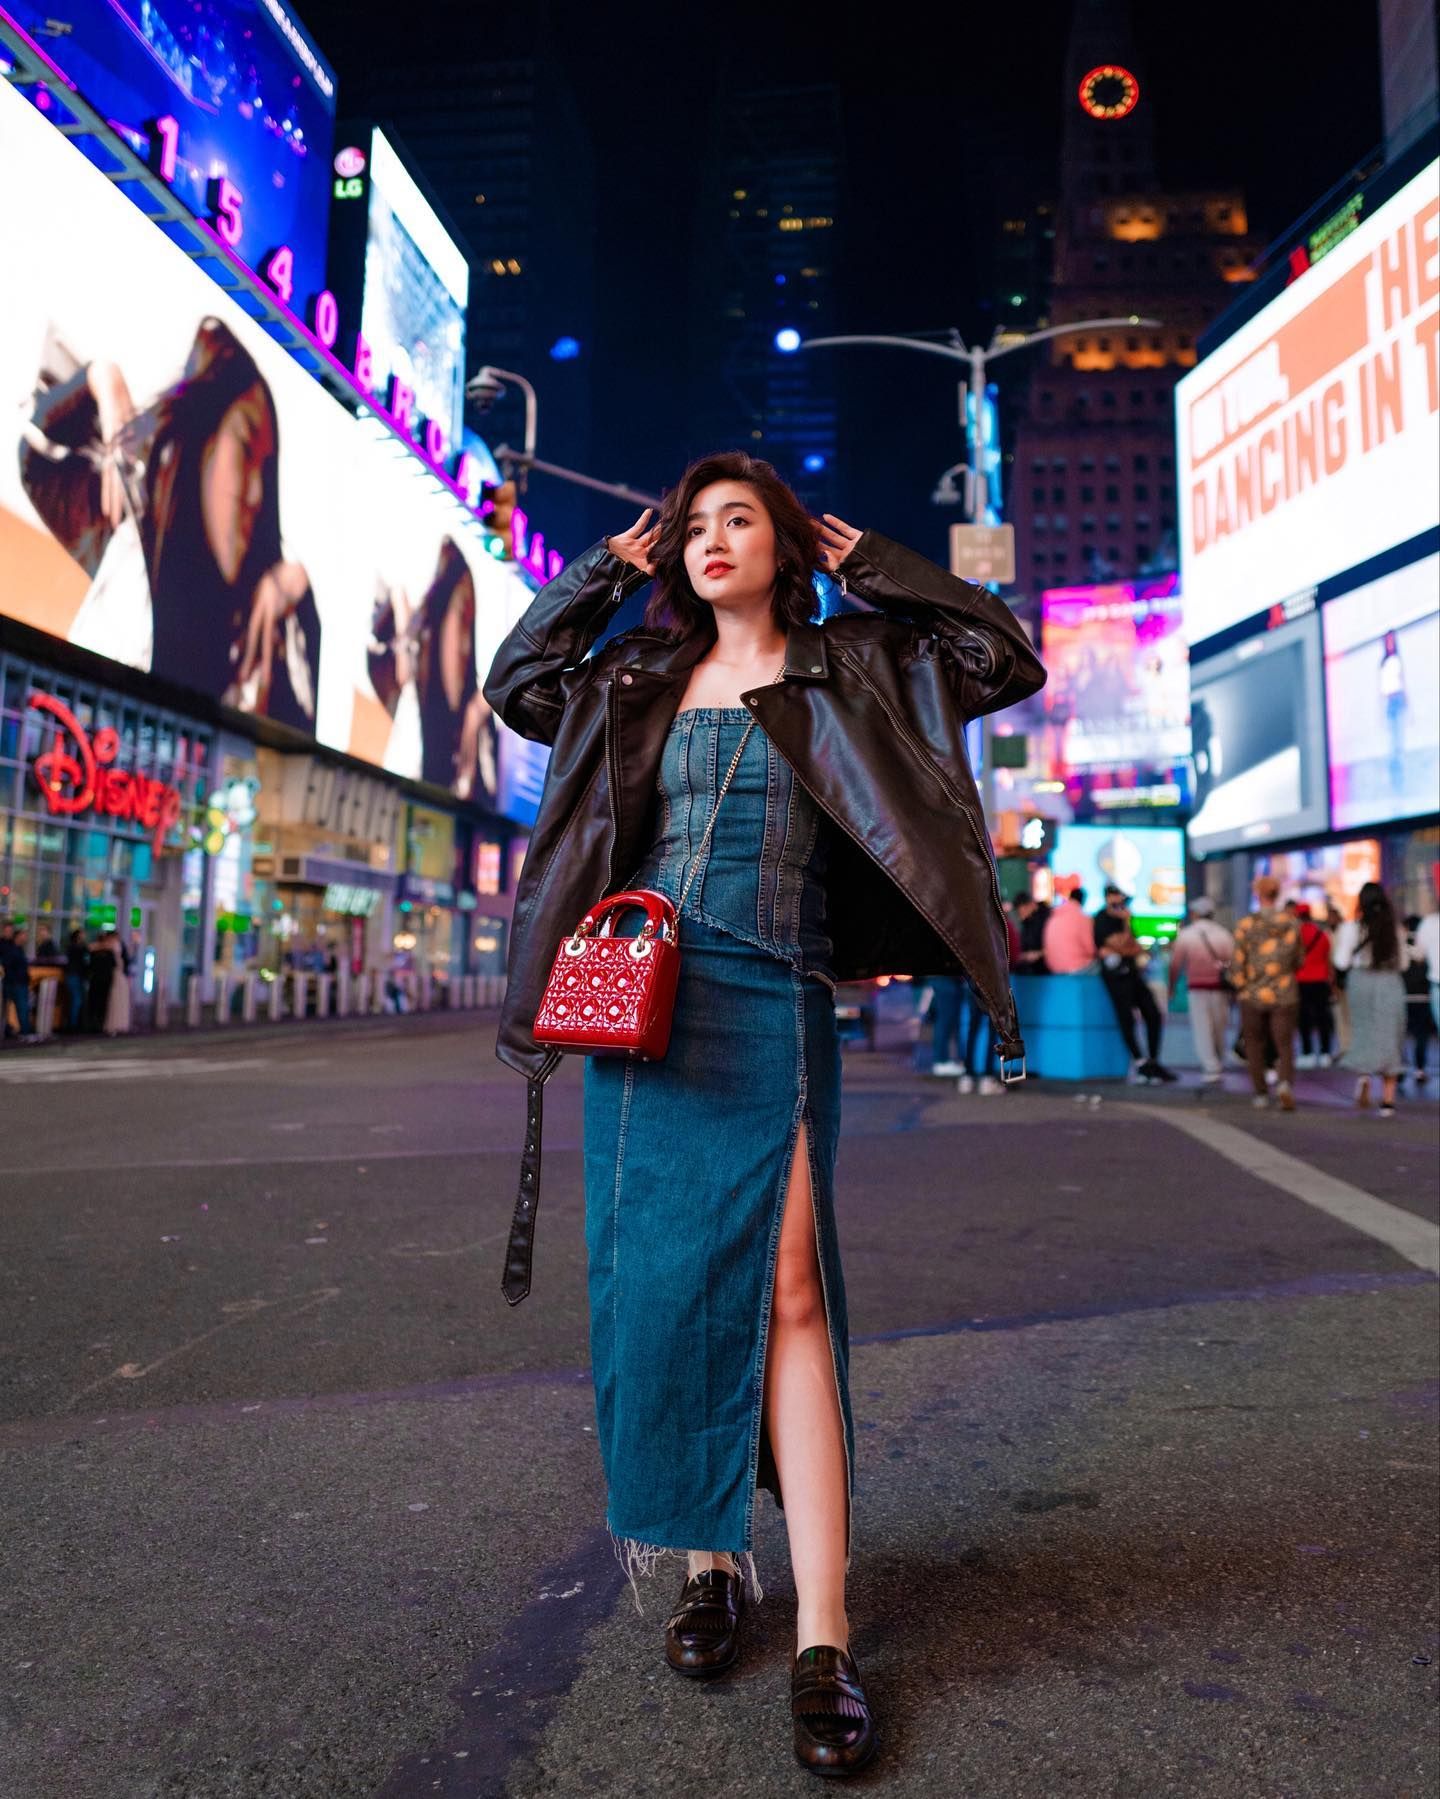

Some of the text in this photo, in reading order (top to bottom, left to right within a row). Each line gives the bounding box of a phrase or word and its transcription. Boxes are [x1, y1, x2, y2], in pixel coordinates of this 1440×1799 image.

[334, 179, 363, 199] LG
[156, 114, 563, 580] 1540 BROAWAY
[1191, 380, 1347, 556] DANCING
[1359, 338, 1404, 455] IN
